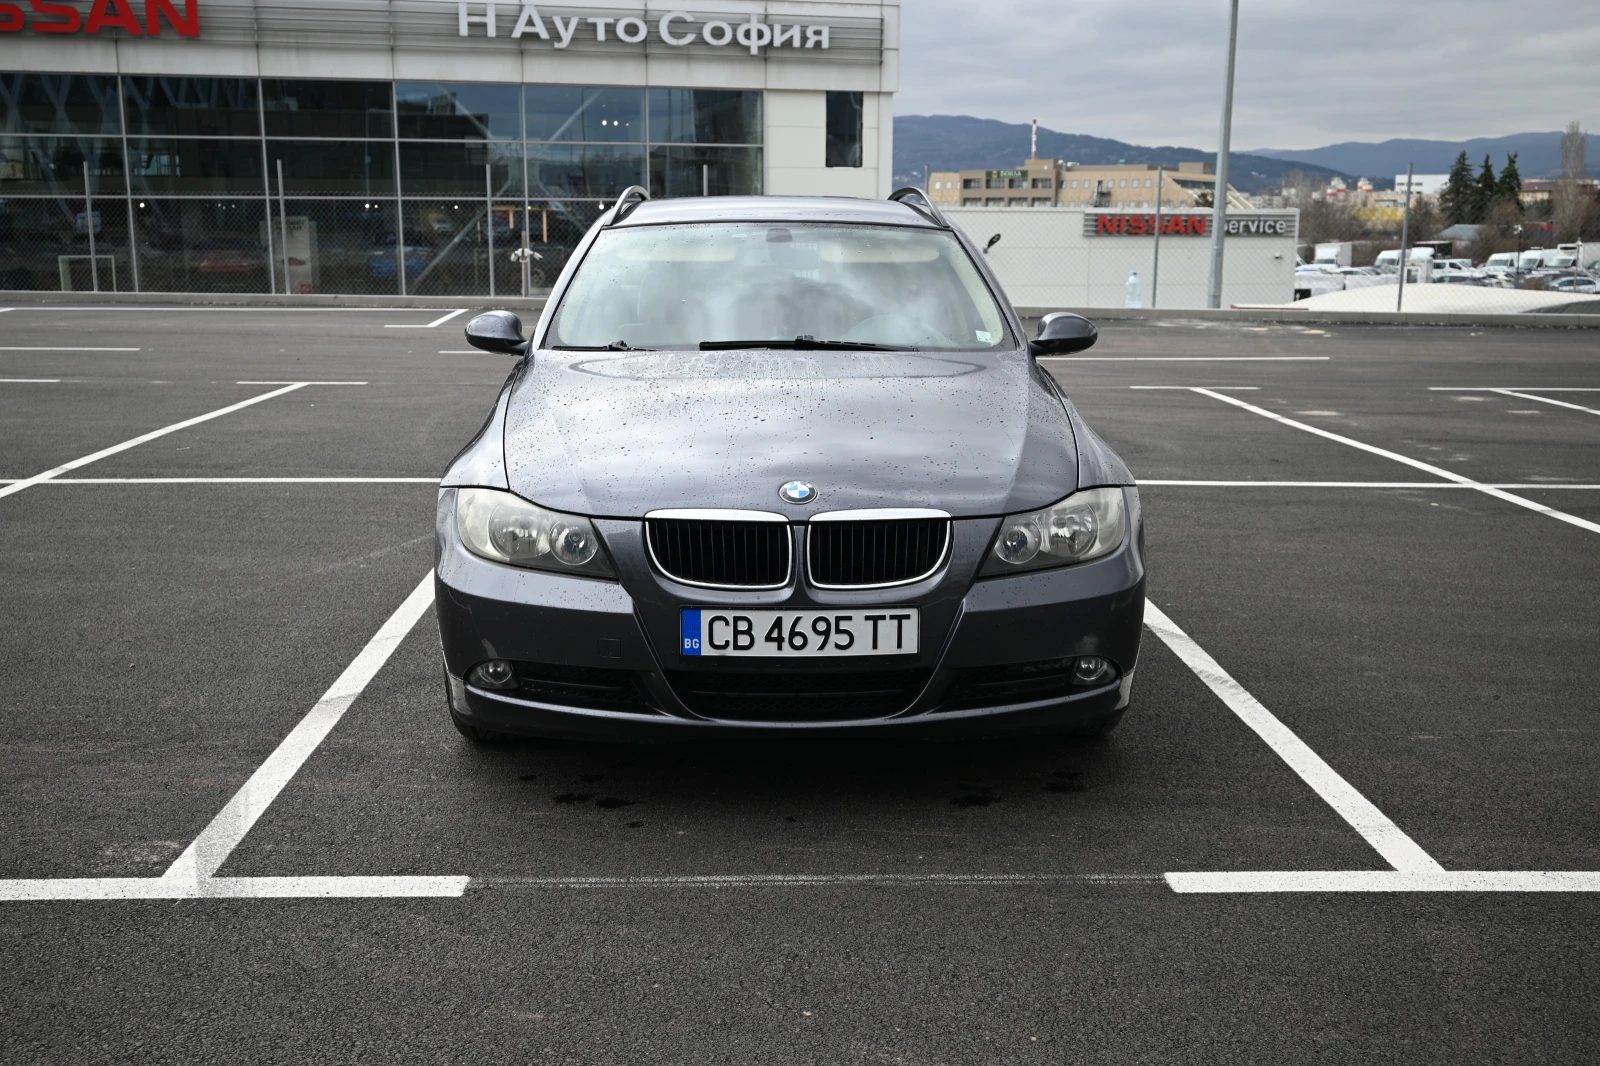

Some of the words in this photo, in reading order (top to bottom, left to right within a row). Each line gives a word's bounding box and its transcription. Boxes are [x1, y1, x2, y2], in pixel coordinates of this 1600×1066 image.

[659, 11, 829, 54] София
[1098, 215, 1207, 234] NISSAN
[1224, 217, 1287, 233] ervice
[684, 639, 700, 649] BG
[765, 615, 855, 651] 4695
[865, 614, 911, 649] TT
